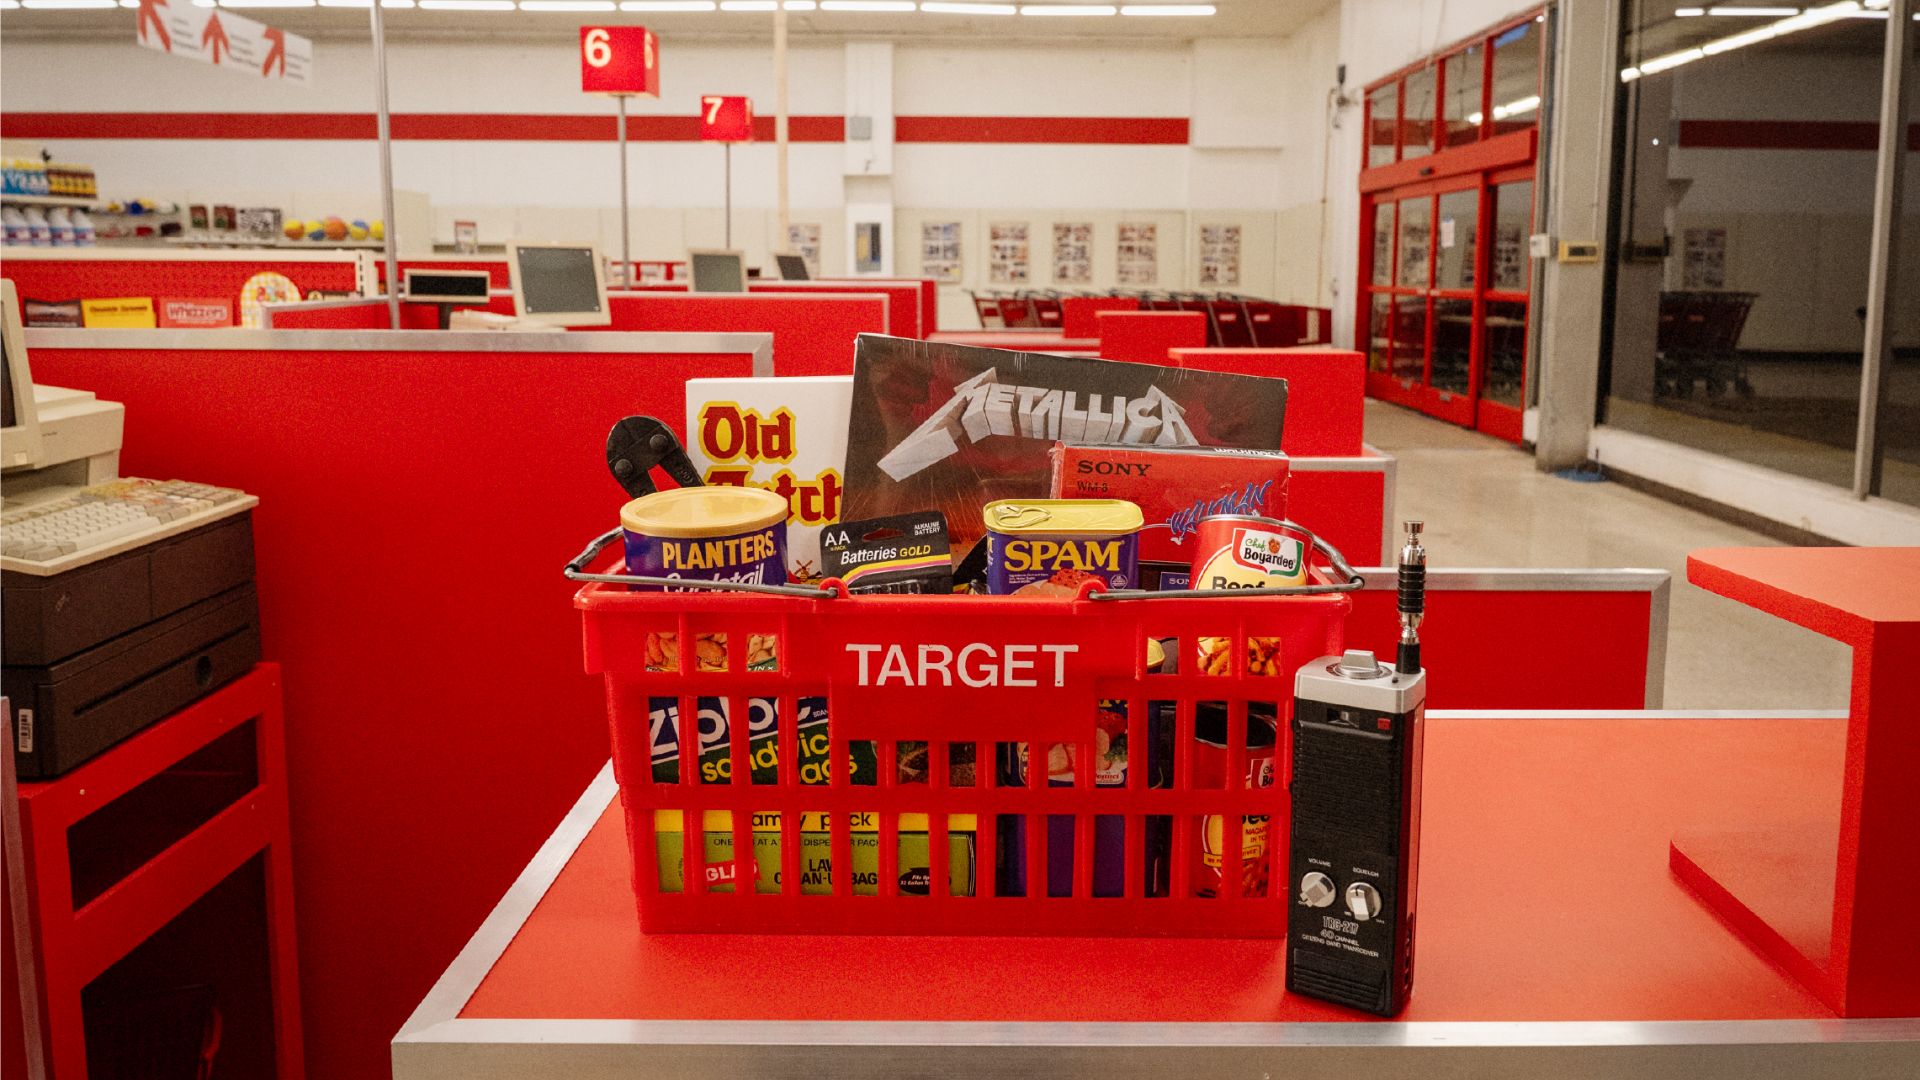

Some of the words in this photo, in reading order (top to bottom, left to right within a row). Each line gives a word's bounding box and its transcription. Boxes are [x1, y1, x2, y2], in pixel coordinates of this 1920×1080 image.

[585, 29, 611, 67] 6
[704, 97, 722, 125] 7
[703, 406, 792, 460] Old
[877, 367, 1200, 482] METALLICA
[1077, 460, 1152, 477] SONY
[825, 530, 851, 547] AA
[914, 527, 941, 536] BATTERY
[840, 546, 897, 565] Batteries
[899, 544, 931, 557] GOLD
[1245, 538, 1267, 552] Chef
[1004, 540, 1122, 572] SPAM
[1243, 547, 1294, 570] Boyardee
[1168, 577, 1190, 585] SON
[845, 643, 1079, 688] TARGET
[820, 812, 871, 830] pck
[713, 838, 732, 847] ONE
[852, 873, 878, 885] BAG
